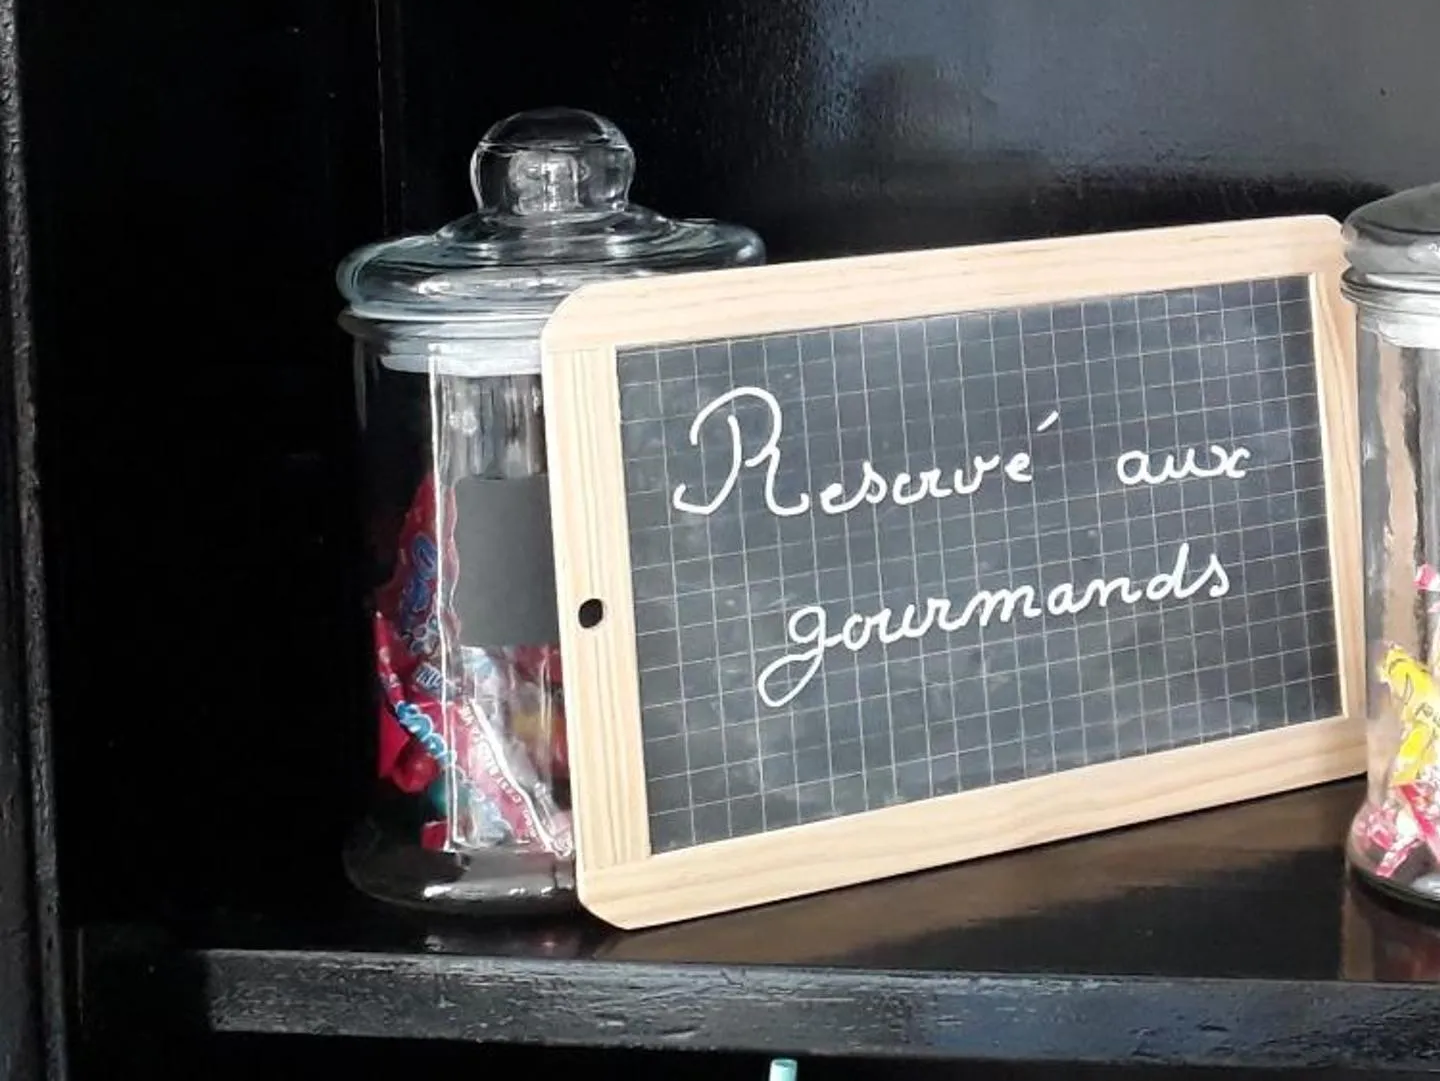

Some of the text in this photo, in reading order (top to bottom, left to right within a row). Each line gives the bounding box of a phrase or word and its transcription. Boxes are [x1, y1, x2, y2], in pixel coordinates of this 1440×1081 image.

[673, 386, 1251, 516] Reservé aux
[757, 542, 1231, 708] gourmands
